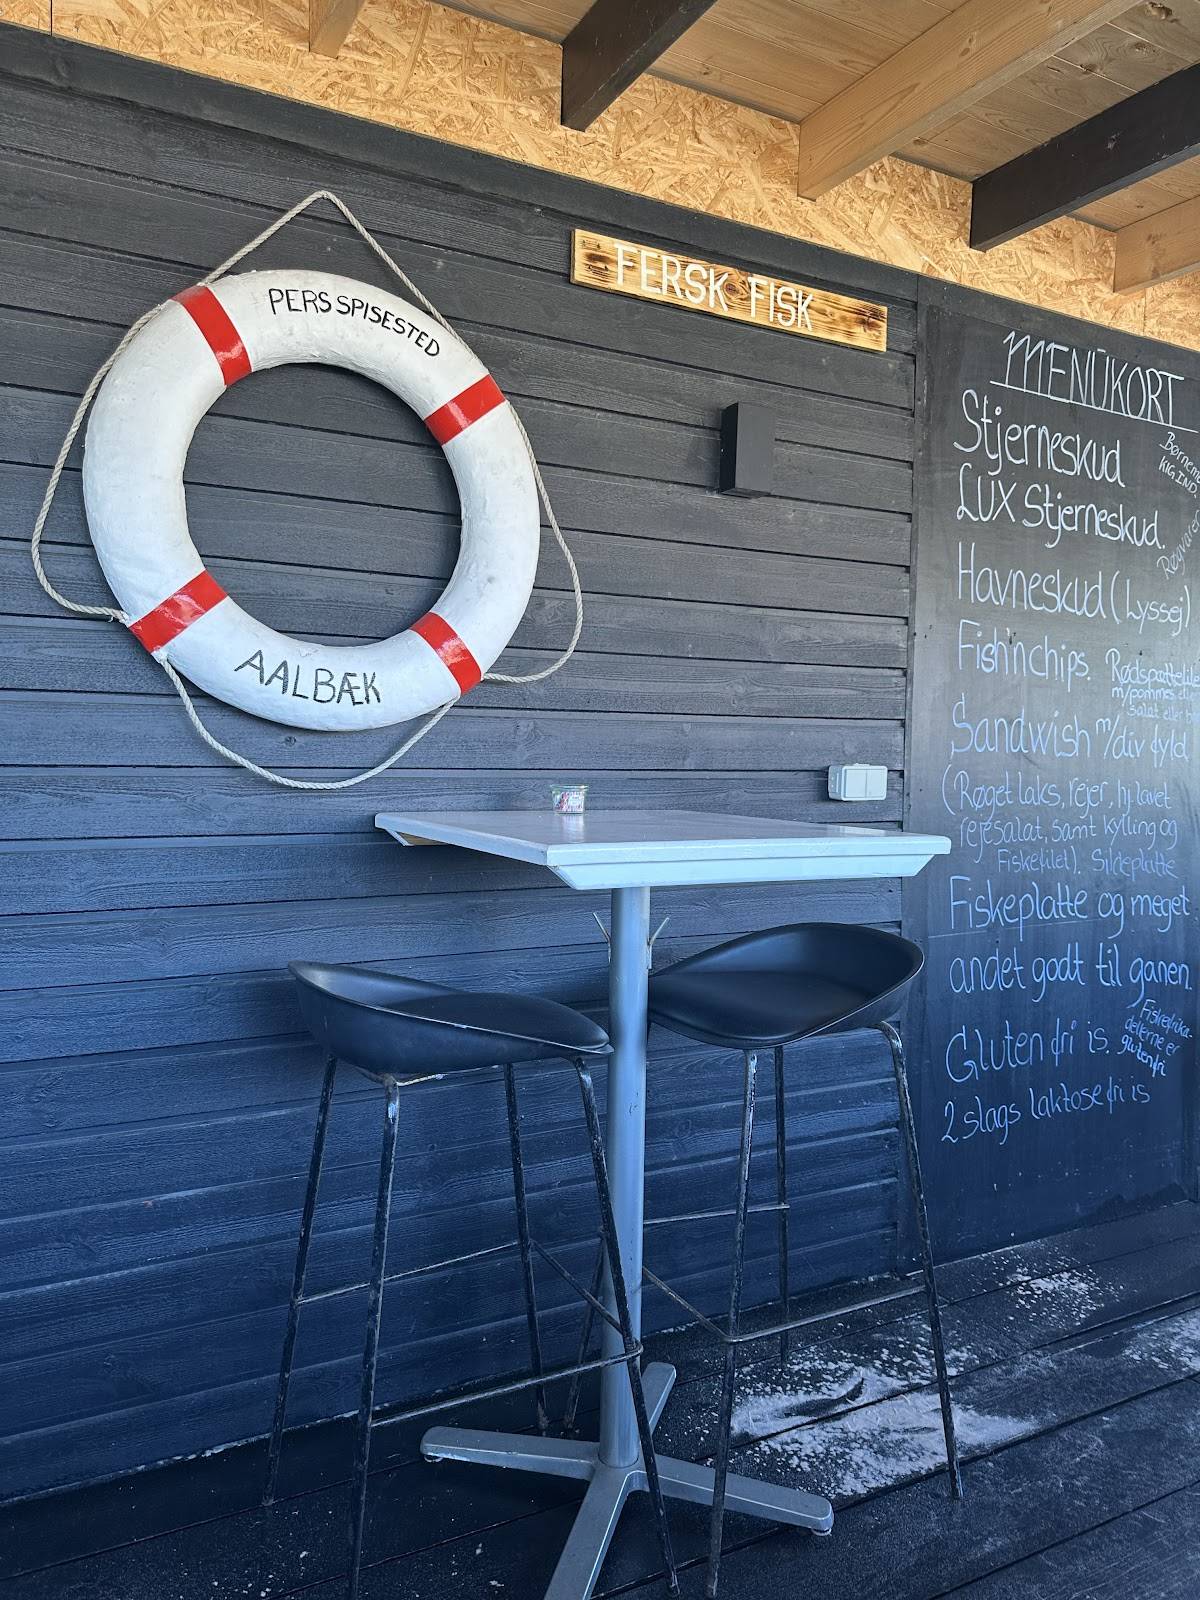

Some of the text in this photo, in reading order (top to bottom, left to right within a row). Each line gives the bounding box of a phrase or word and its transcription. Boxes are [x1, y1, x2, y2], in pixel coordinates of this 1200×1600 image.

[613, 242, 813, 331] FERSK FISK
[268, 288, 440, 357] PERS SPISESTED
[953, 389, 1126, 488] Stjerneskud
[1022, 483, 1166, 549] Stjerneskud.
[958, 541, 1107, 619] Havneskud
[233, 649, 381, 706] AALBÆK
[950, 693, 1091, 759] Sandwish
[1159, 818, 1178, 850] og
[950, 875, 1190, 942] Fiskeplatte og meget
[949, 942, 1193, 1009] andet godt til ganen.
[945, 1019, 1043, 1083] Gluten
[940, 1100, 959, 1143] 2
[962, 1095, 1022, 1146] slags
